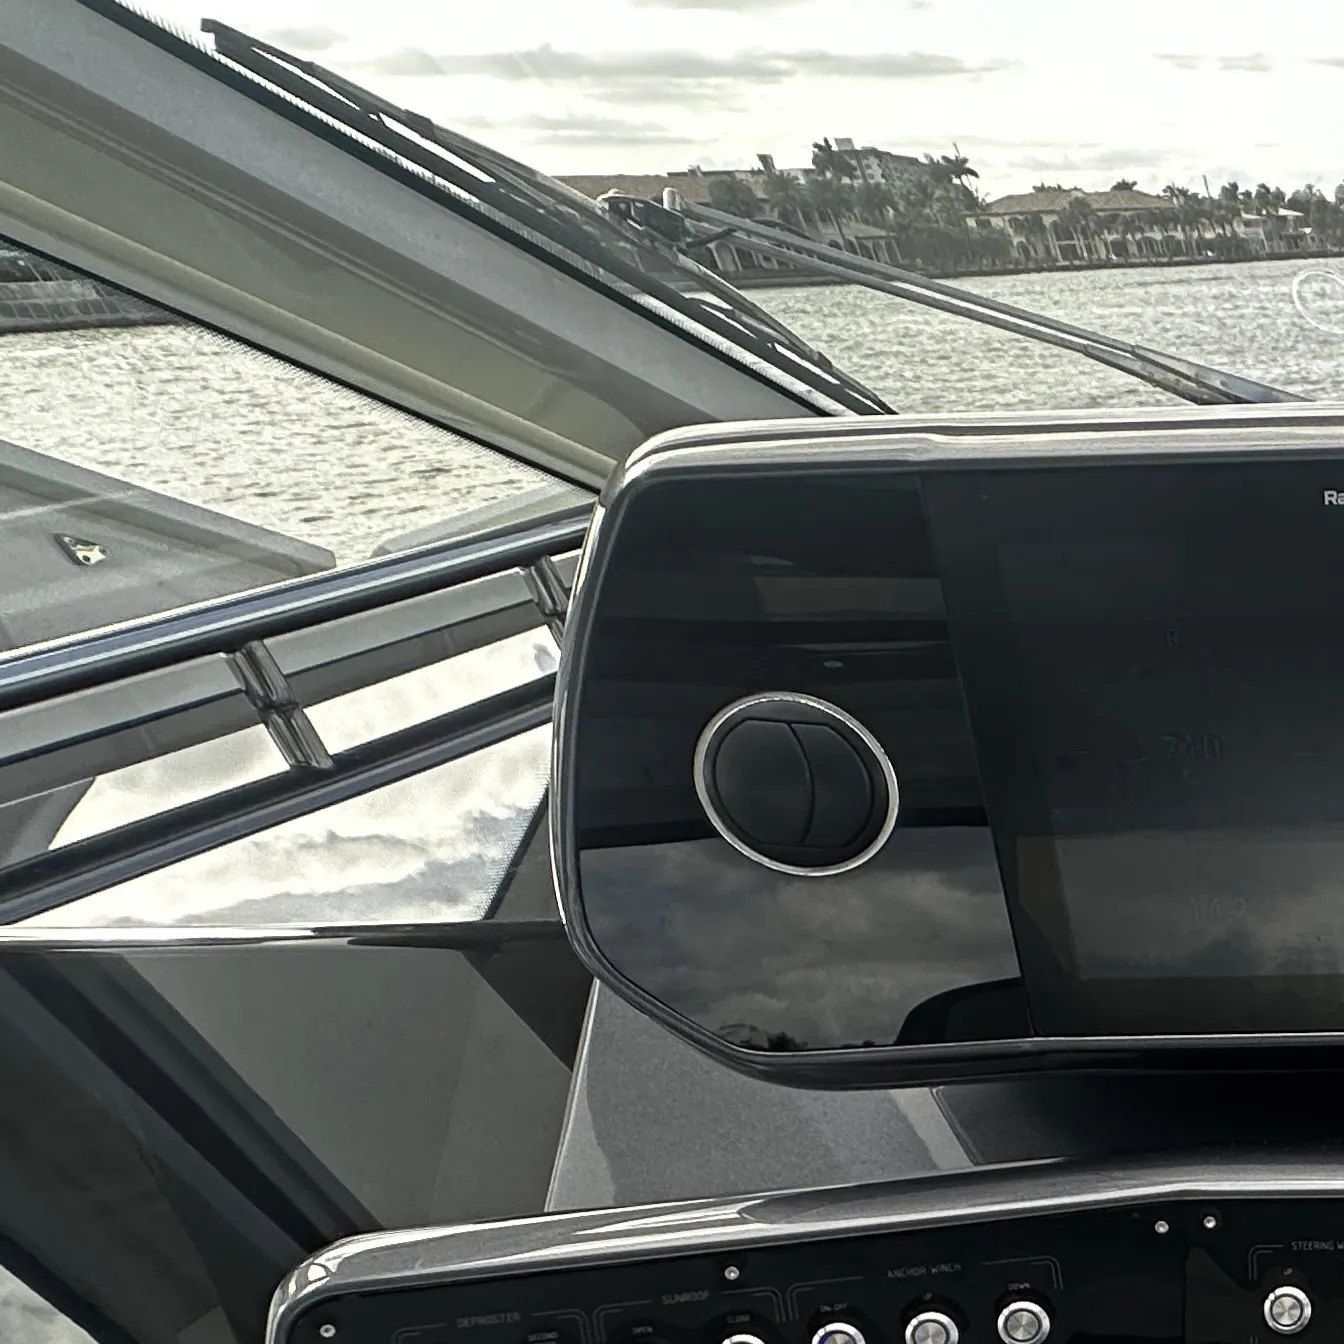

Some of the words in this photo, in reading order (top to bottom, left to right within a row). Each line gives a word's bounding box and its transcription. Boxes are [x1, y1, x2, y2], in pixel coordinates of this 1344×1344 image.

[1291, 1241, 1334, 1251] STEERING
[887, 1265, 928, 1279] ANCHOR
[930, 1262, 962, 1275] WINCH
